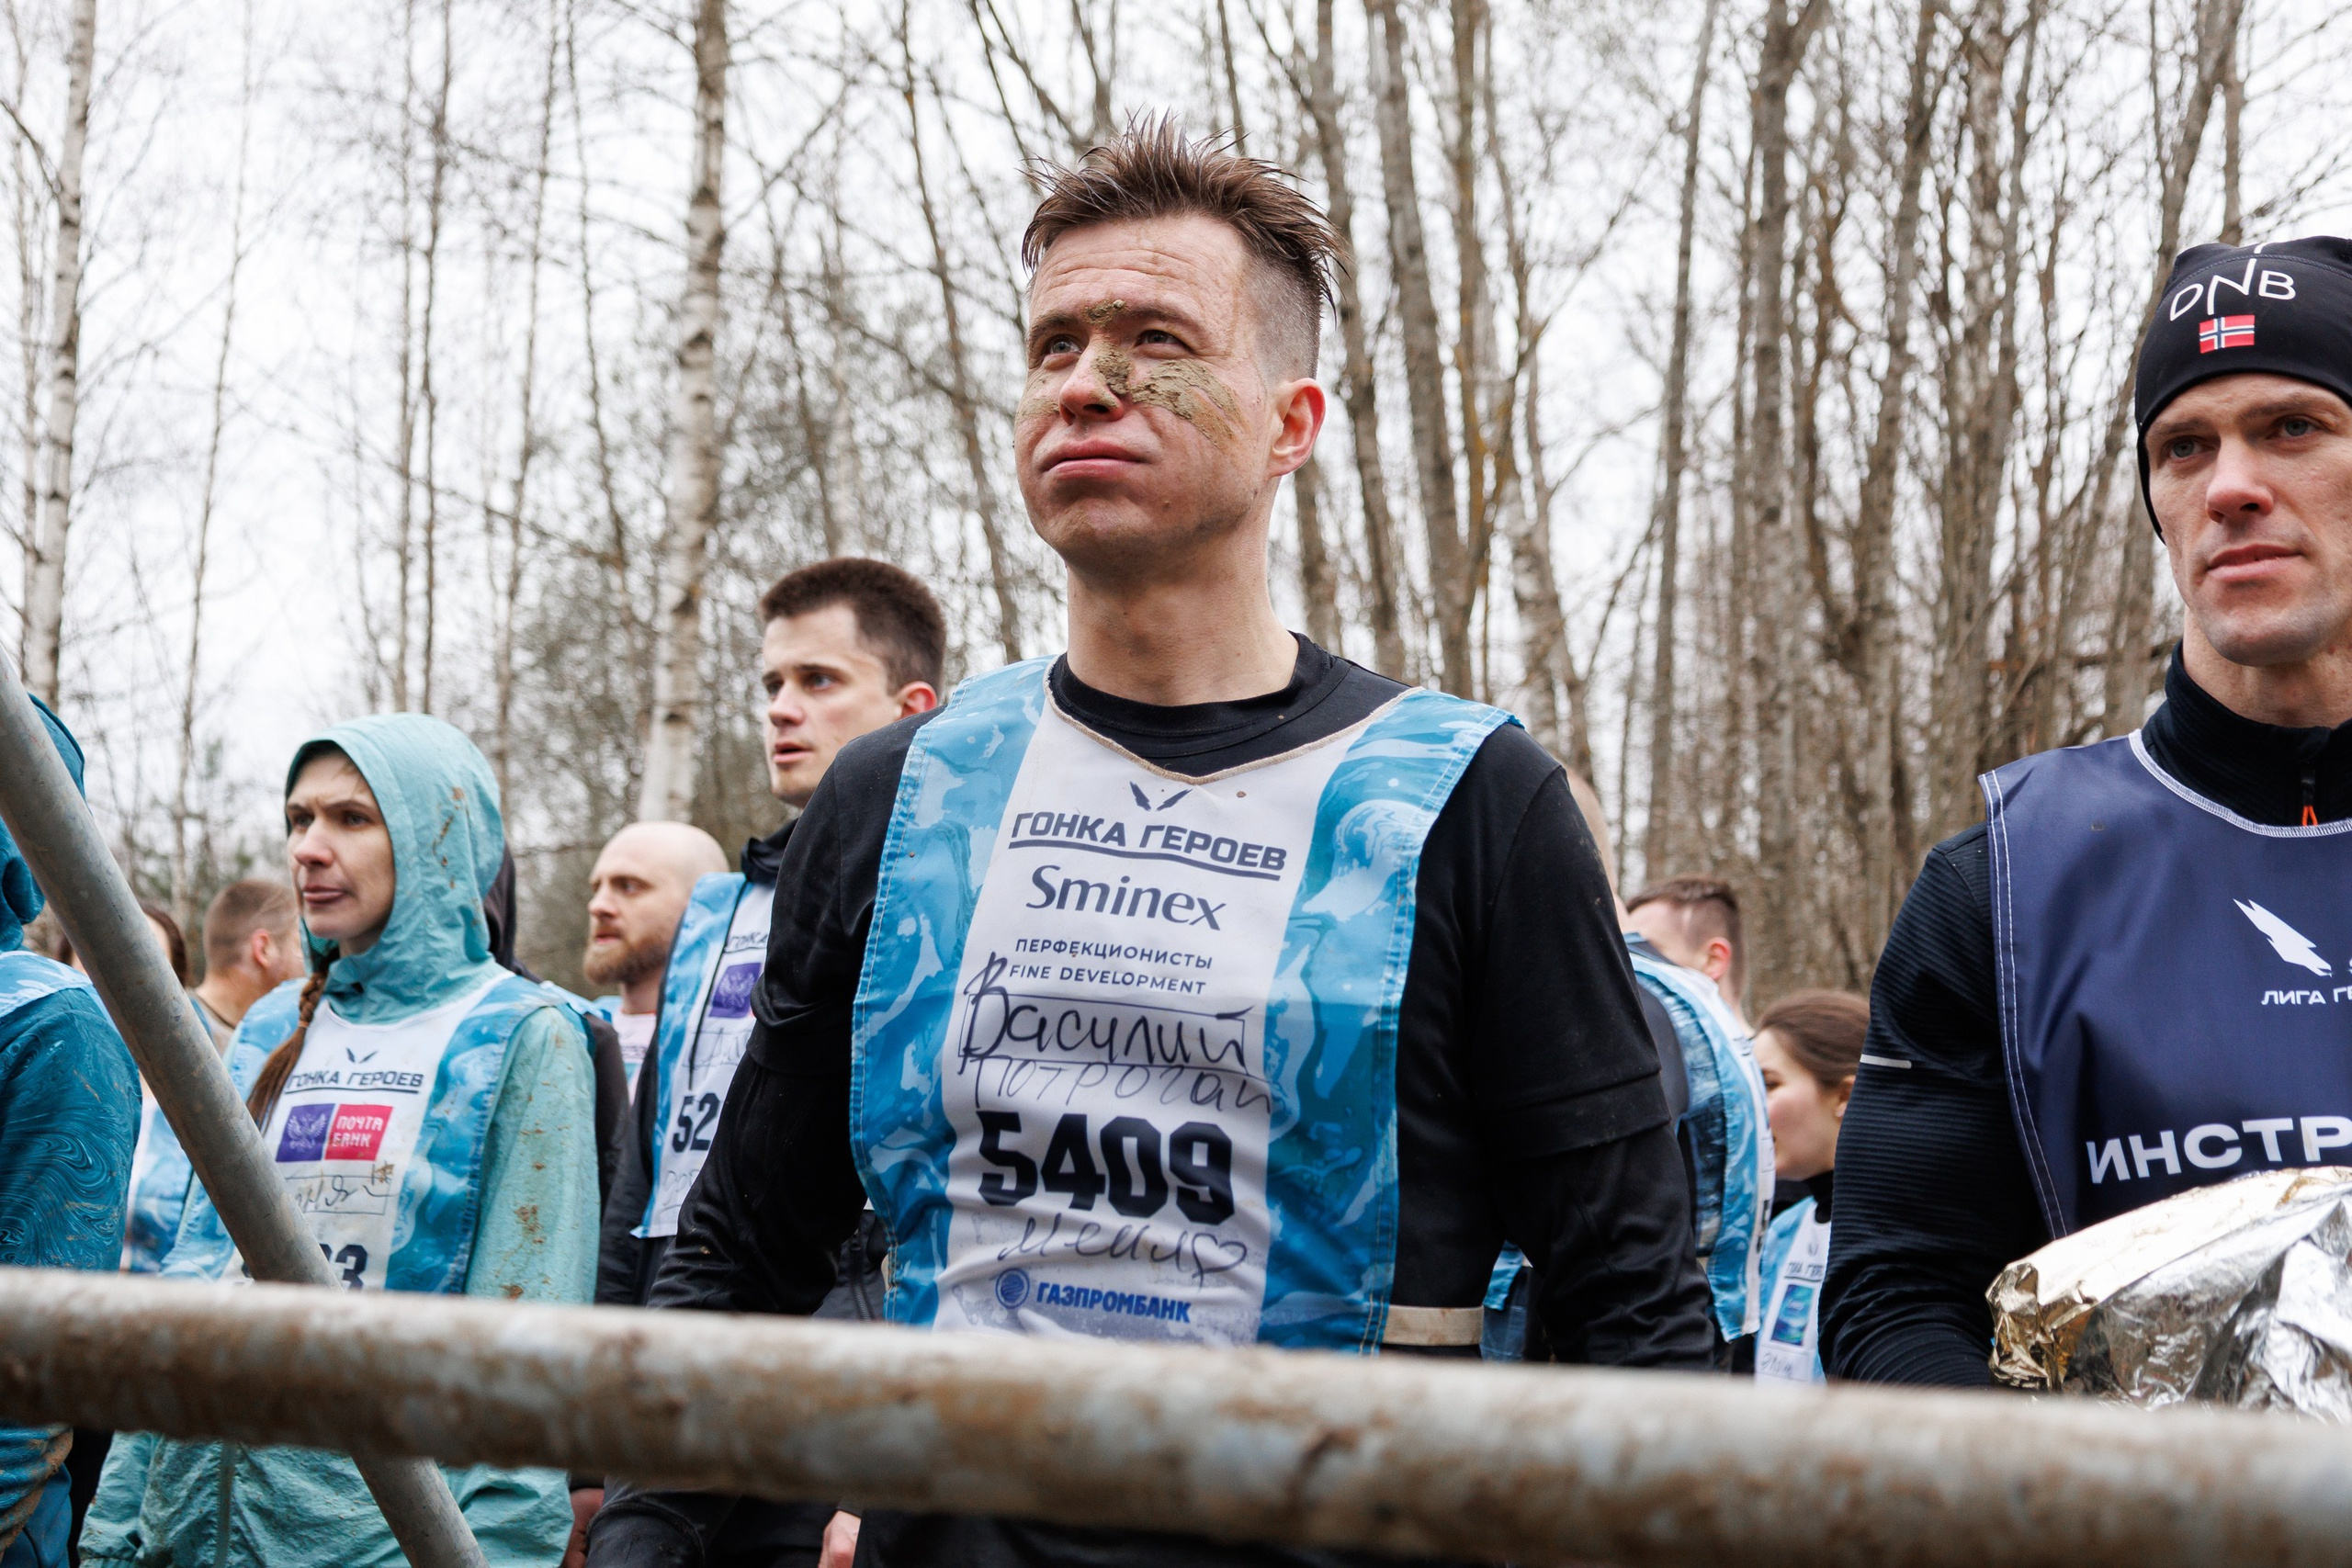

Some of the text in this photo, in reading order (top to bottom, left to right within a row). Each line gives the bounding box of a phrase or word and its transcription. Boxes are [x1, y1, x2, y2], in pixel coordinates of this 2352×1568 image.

[2169, 241, 2296, 321] DNB
[1011, 811, 1287, 872] ГОНКА ГЕРОЕВ
[1025, 863, 1227, 931] Sminex
[1014, 938, 1214, 970] ПЕРФЕКЦИОНИСТЫ
[1009, 964, 1207, 996] FINE DEVELOPMENT
[2261, 989, 2327, 1006] ЛИГА
[958, 952, 1255, 1075] Василий
[287, 1070, 424, 1089] ГОНКА ГЕРОЕВ
[332, 1132, 373, 1148] БАНК
[336, 1114, 384, 1132] ПОЧТА
[976, 1110, 1236, 1226] 5409
[2086, 1115, 2352, 1185] ИНСТР
[1035, 1281, 1192, 1324] ГАЗПРОМБАНК
